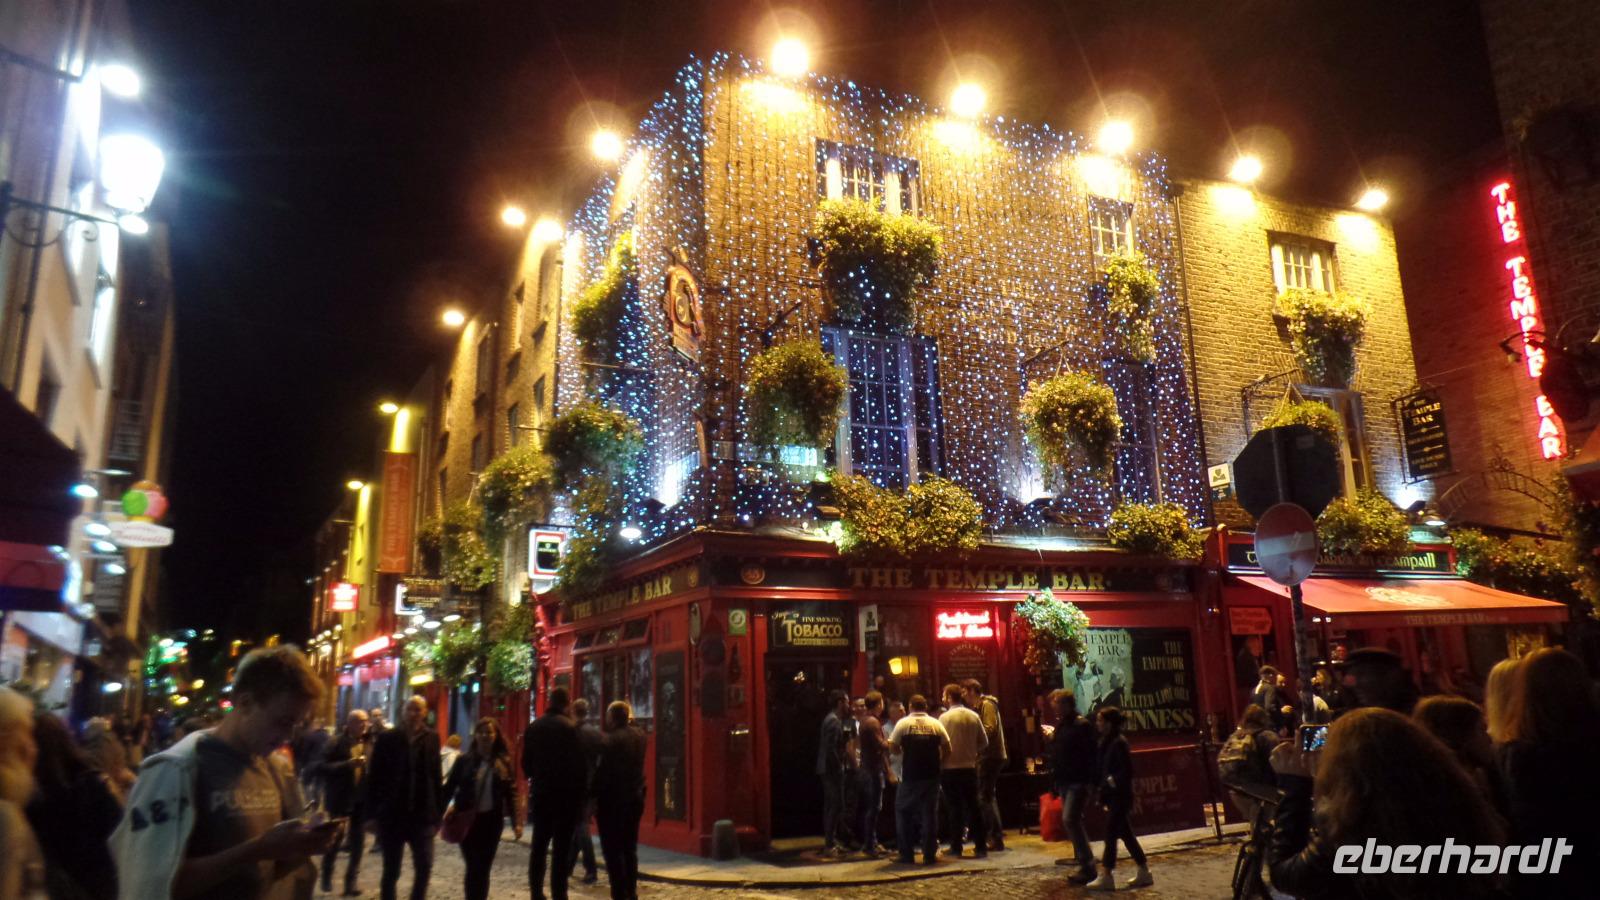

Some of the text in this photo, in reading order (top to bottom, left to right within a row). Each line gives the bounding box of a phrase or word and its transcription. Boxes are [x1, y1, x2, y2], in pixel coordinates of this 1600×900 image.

[1491, 183, 1561, 459] THE TEMPLE BAR
[644, 575, 672, 600] BAR
[850, 568, 912, 588] THE
[924, 569, 1039, 590] TEMPLE
[783, 620, 842, 642] TOBACCO
[1131, 774, 1177, 794] EMPLE
